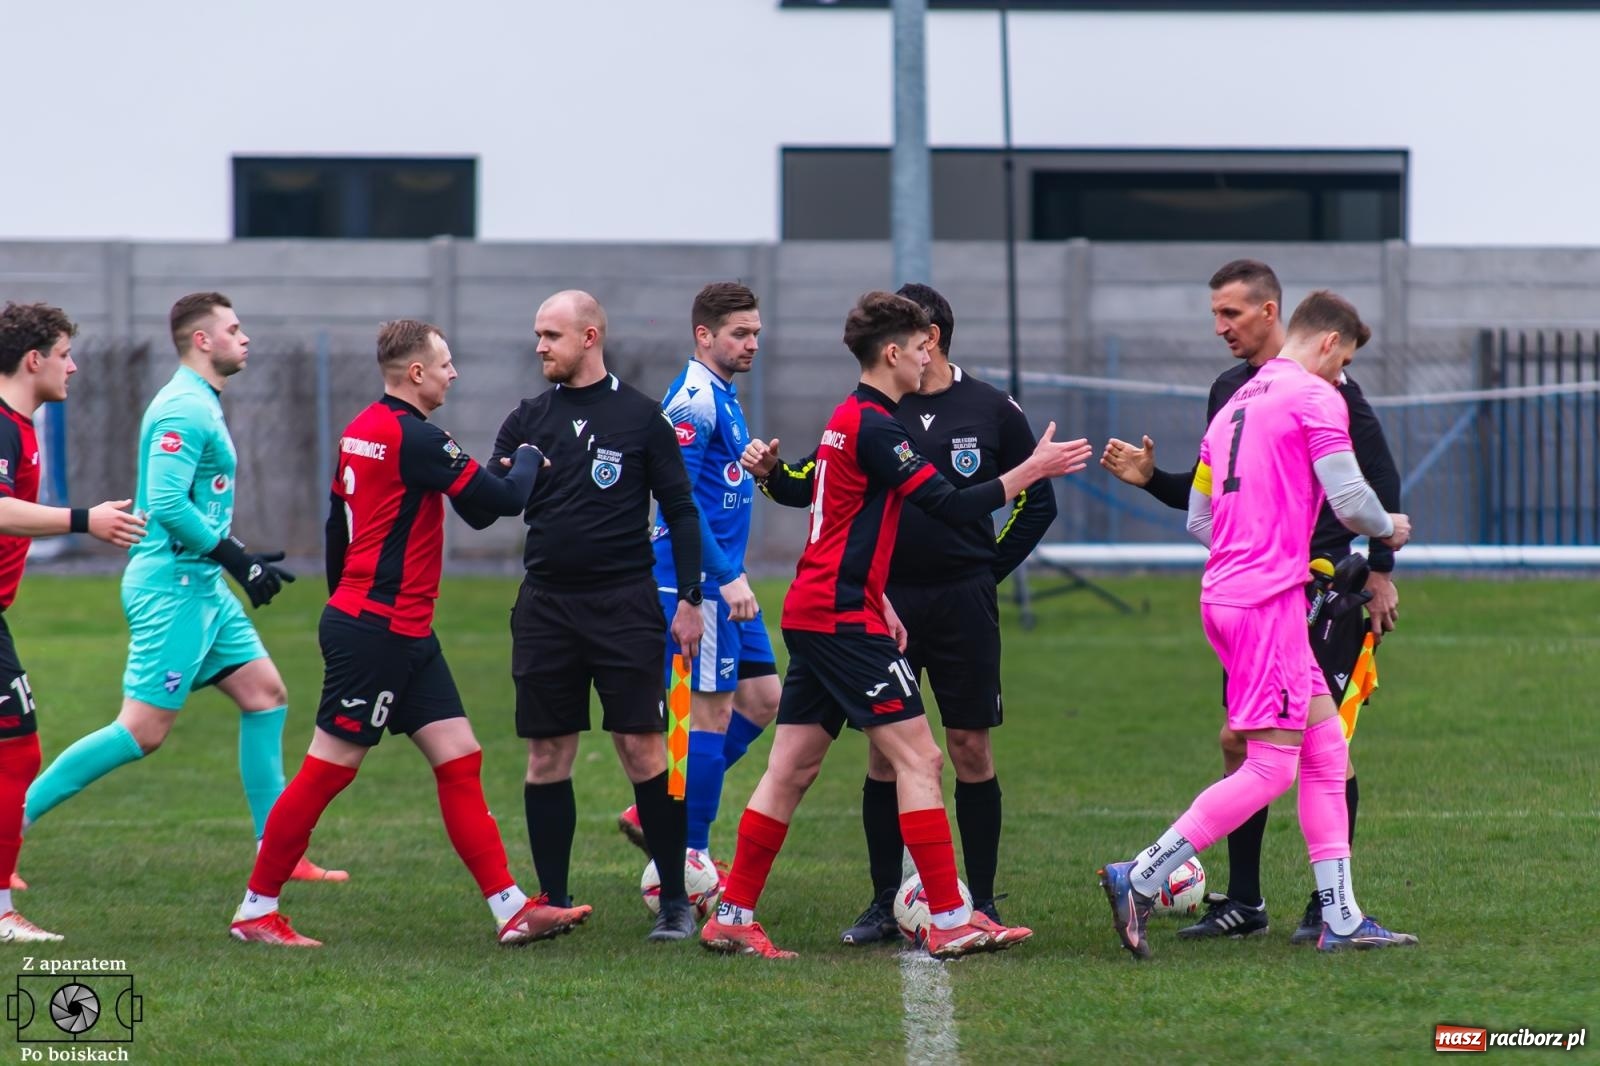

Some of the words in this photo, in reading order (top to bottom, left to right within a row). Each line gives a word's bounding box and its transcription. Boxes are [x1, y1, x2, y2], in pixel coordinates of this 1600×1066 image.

[1222, 407, 1246, 496] 1
[370, 690, 394, 728] 6
[1277, 688, 1290, 719] 1
